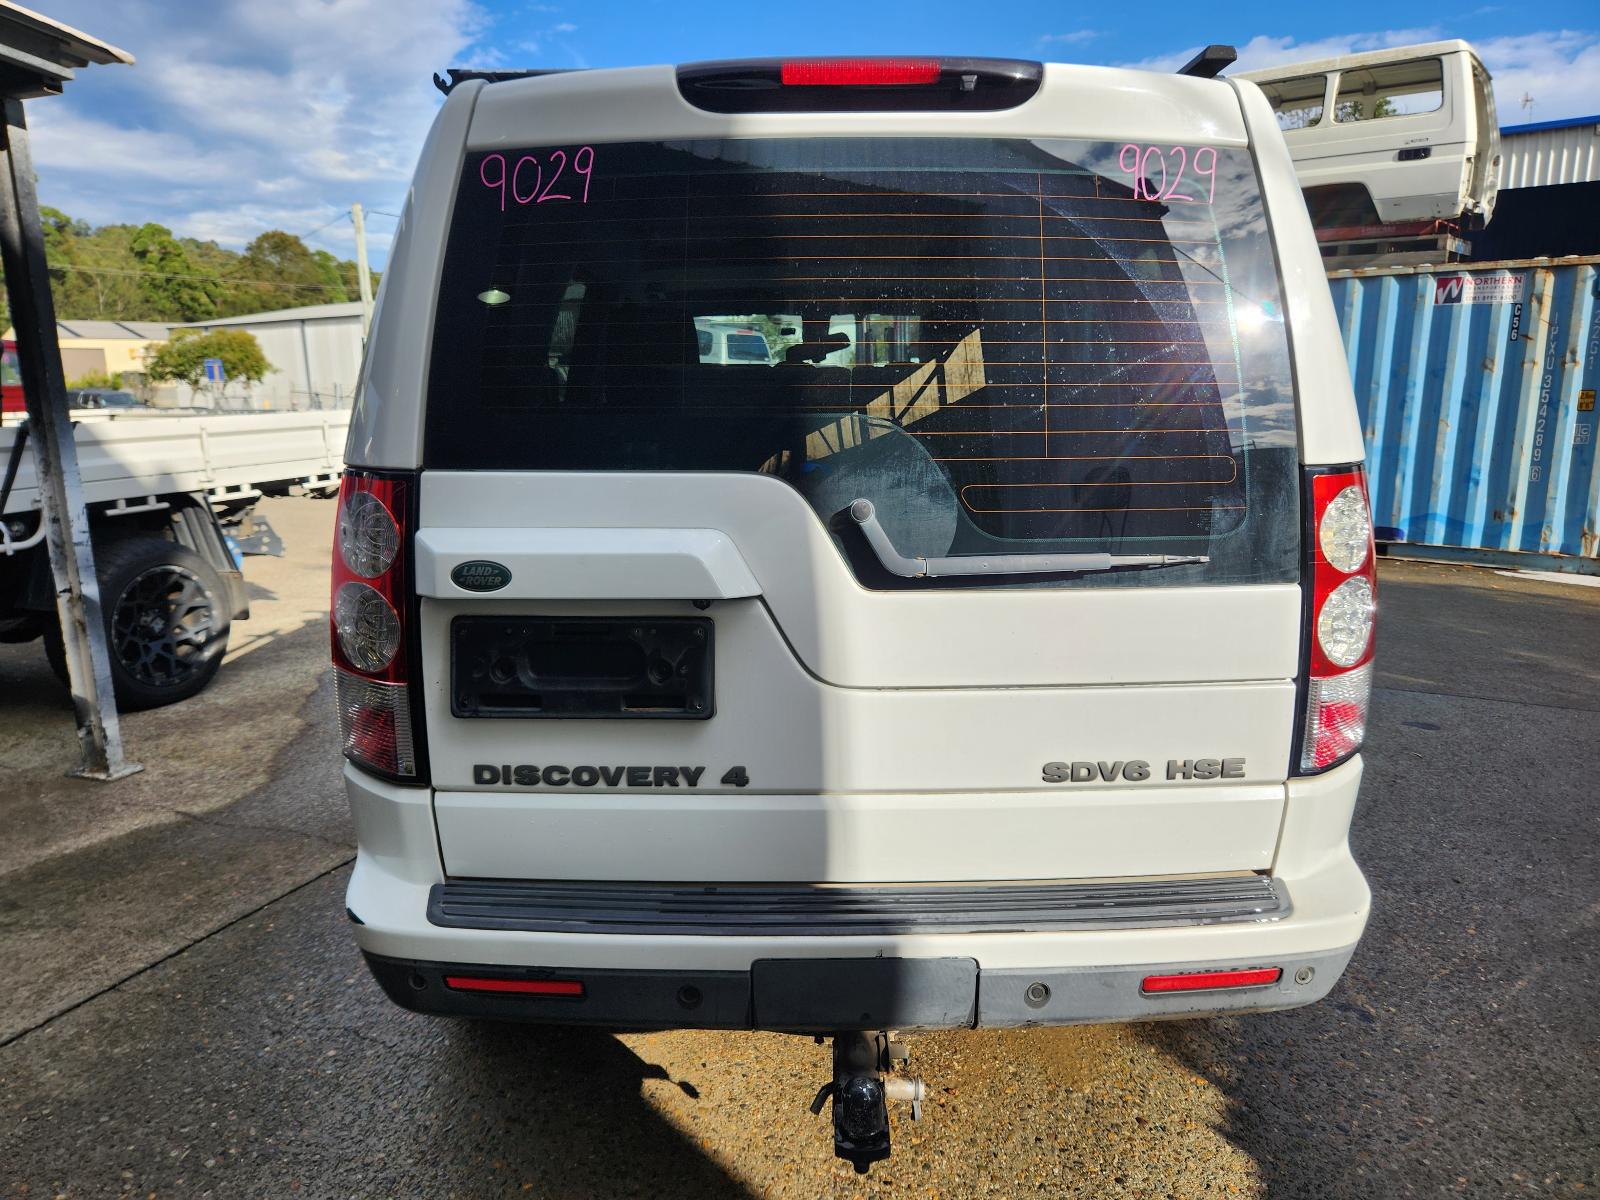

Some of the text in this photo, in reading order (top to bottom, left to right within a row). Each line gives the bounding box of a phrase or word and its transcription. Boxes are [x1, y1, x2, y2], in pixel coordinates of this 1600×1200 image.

[480, 146, 594, 212] 9029
[1120, 143, 1217, 204] 9029
[1465, 276, 1523, 286] NORTHERN
[1511, 304, 1521, 340] C56
[1533, 375, 1552, 462] 354289
[462, 566, 493, 576] LAND
[465, 576, 502, 586] ROVER
[473, 764, 749, 787] DISCOVERY 4
[1042, 758, 1246, 783] SDV6 HSE
